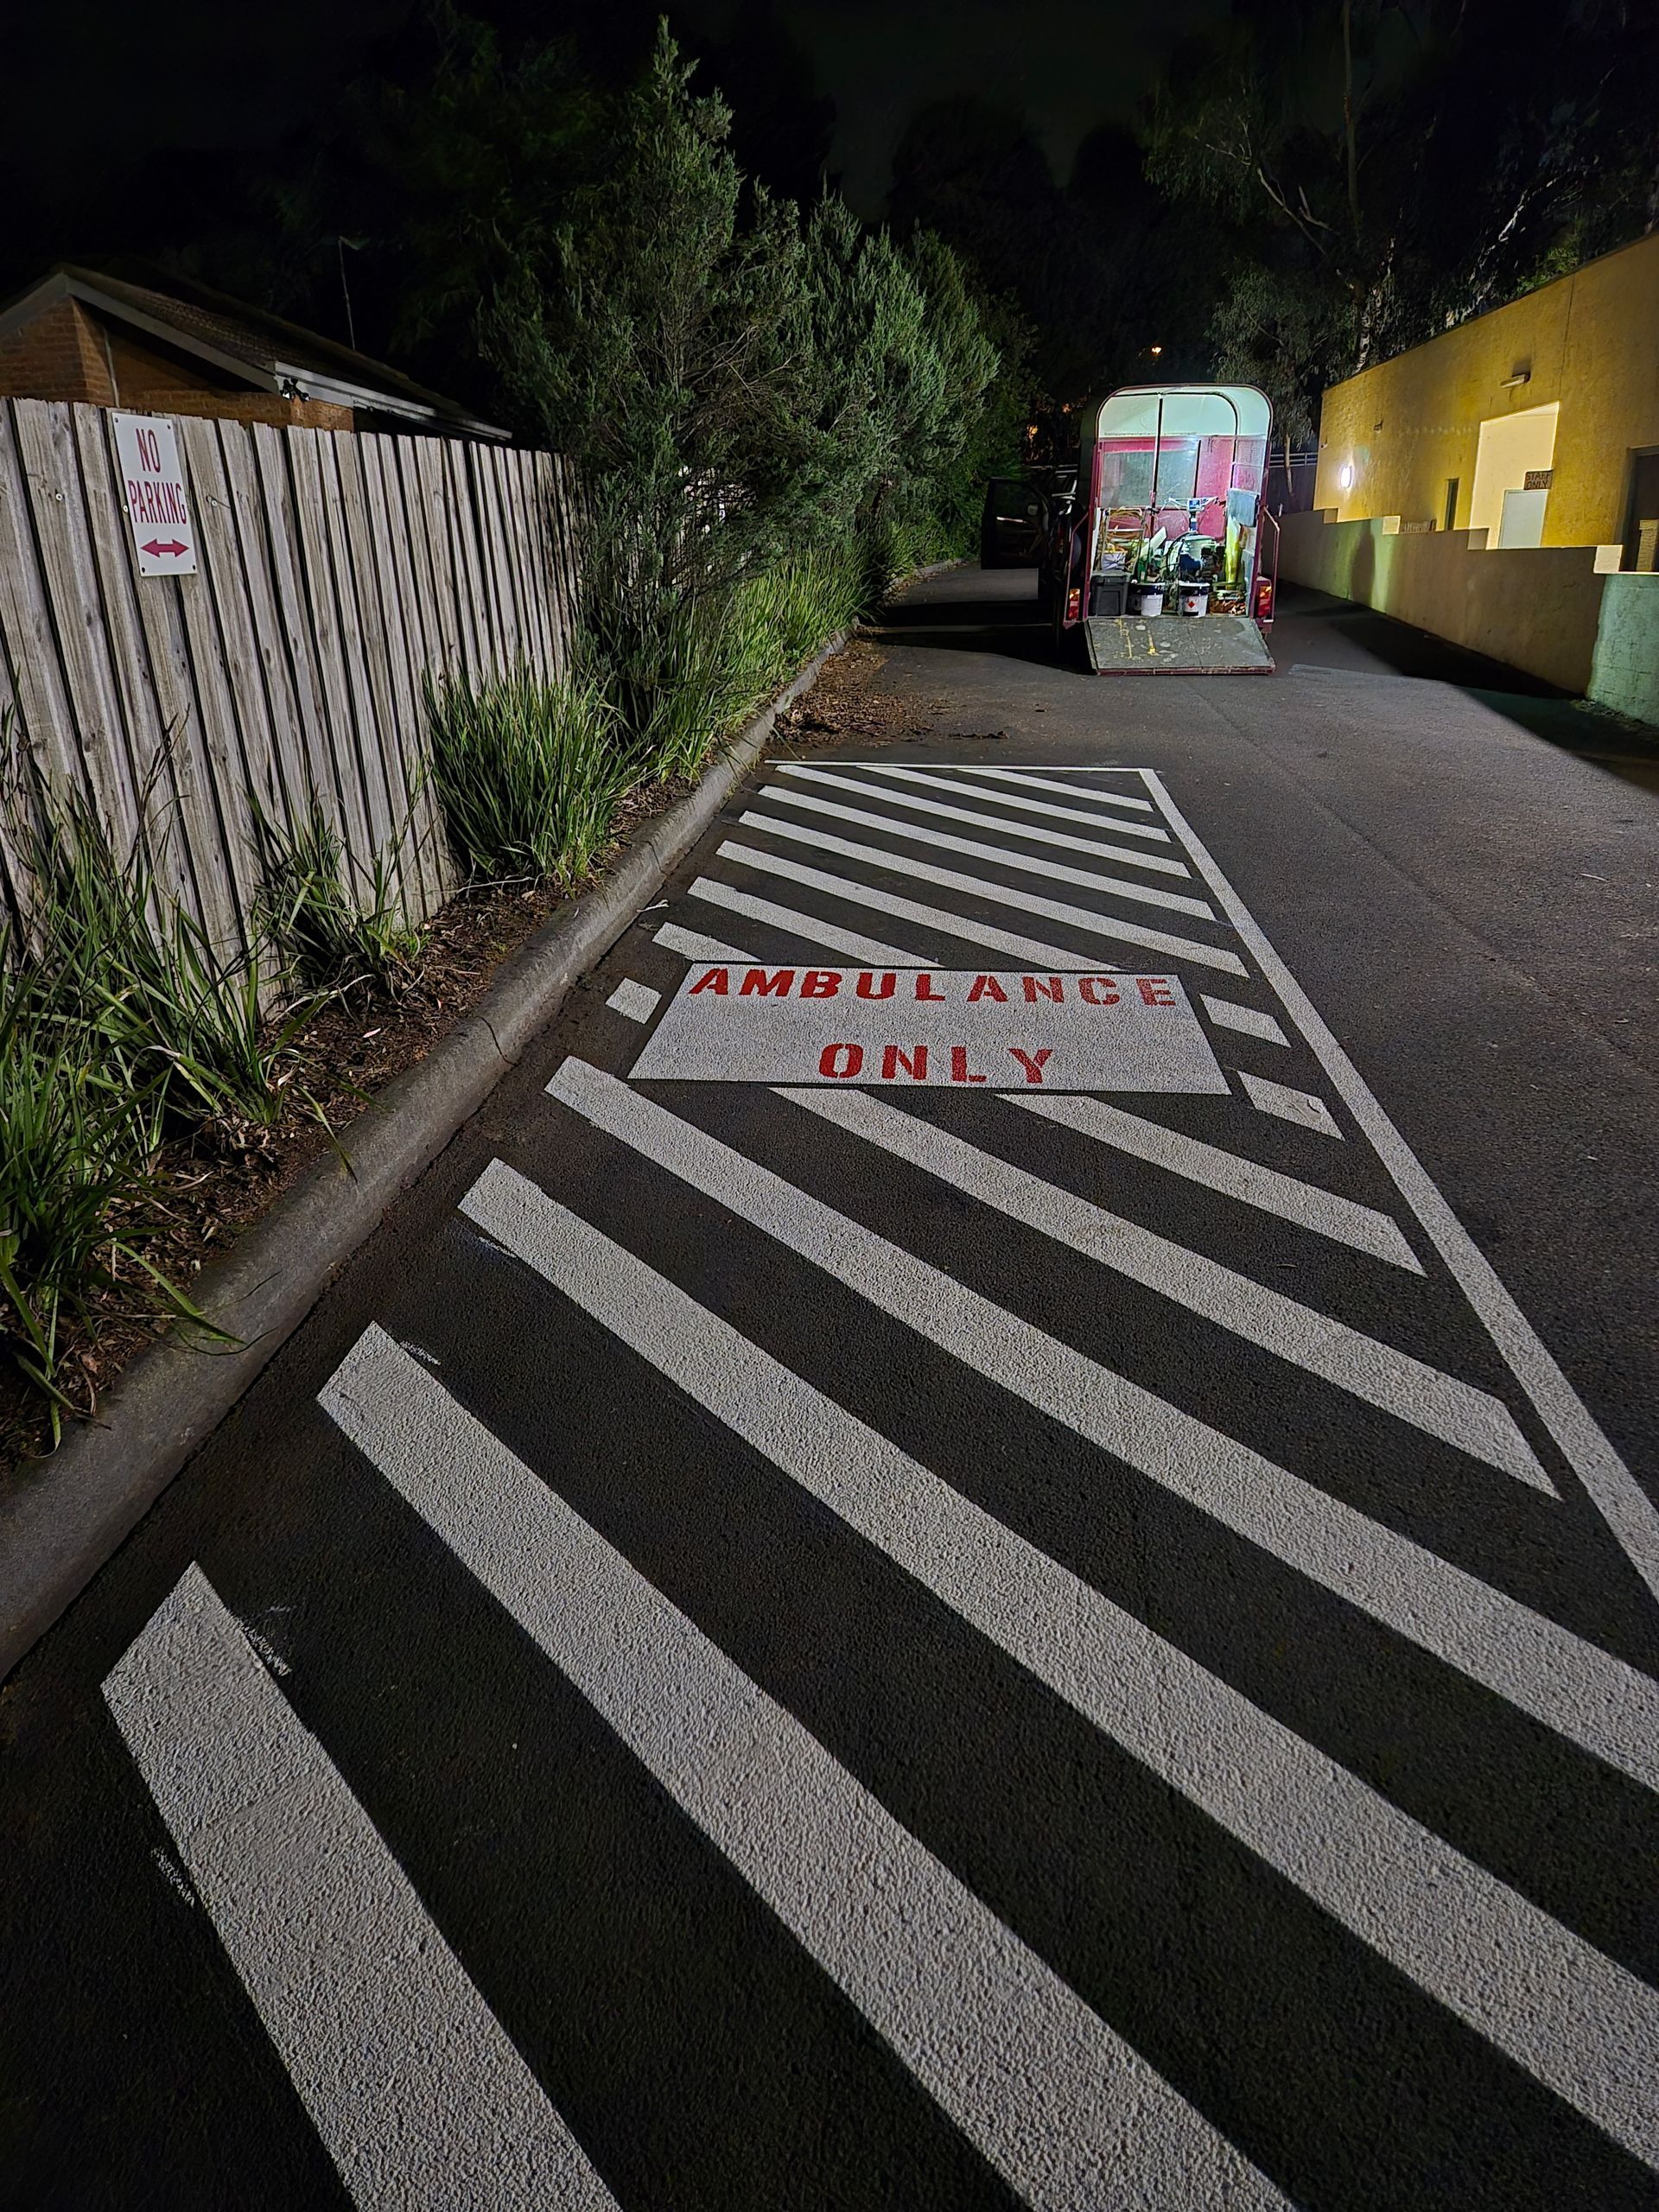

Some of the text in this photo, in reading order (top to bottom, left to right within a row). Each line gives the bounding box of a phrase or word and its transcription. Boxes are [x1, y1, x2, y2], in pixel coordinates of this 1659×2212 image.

[135, 428, 162, 474] NO
[1524, 480, 1548, 490] ONLY
[1525, 471, 1551, 480] STAFF
[127, 480, 188, 525] PARKING
[689, 968, 1176, 1007] AMBULANCE
[818, 1042, 1055, 1084] ONLY
